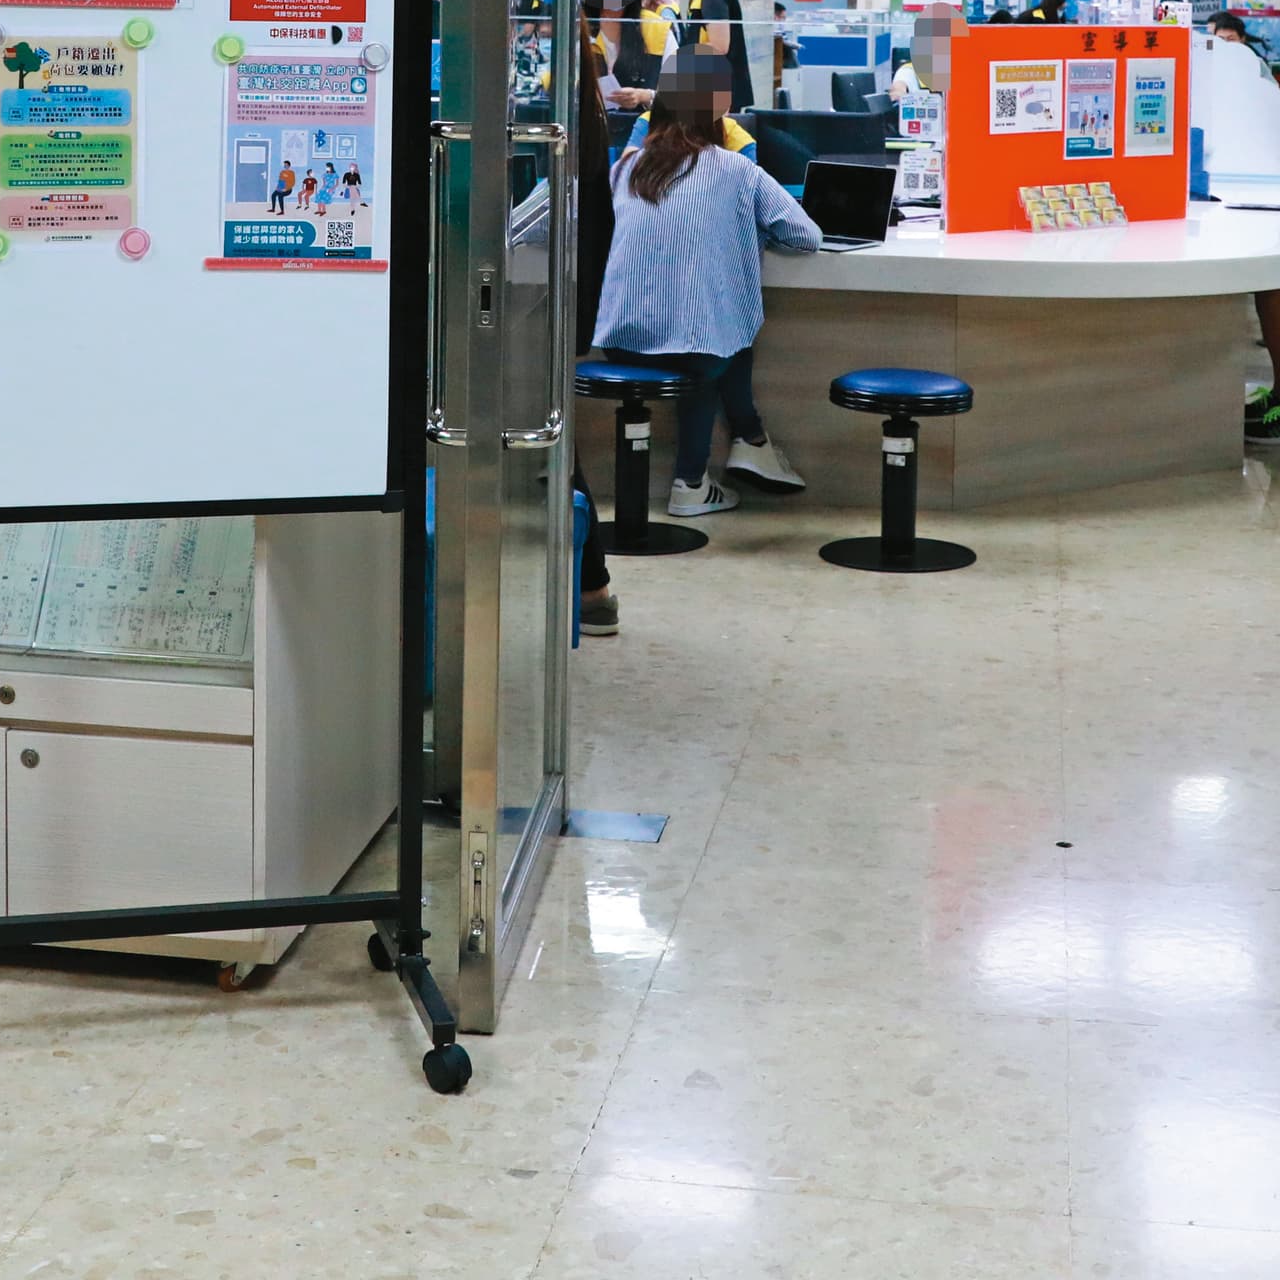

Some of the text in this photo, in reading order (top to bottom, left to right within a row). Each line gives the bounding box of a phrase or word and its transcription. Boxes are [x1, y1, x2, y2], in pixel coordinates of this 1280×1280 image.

[270, 28, 326, 39] 中保科技集團
